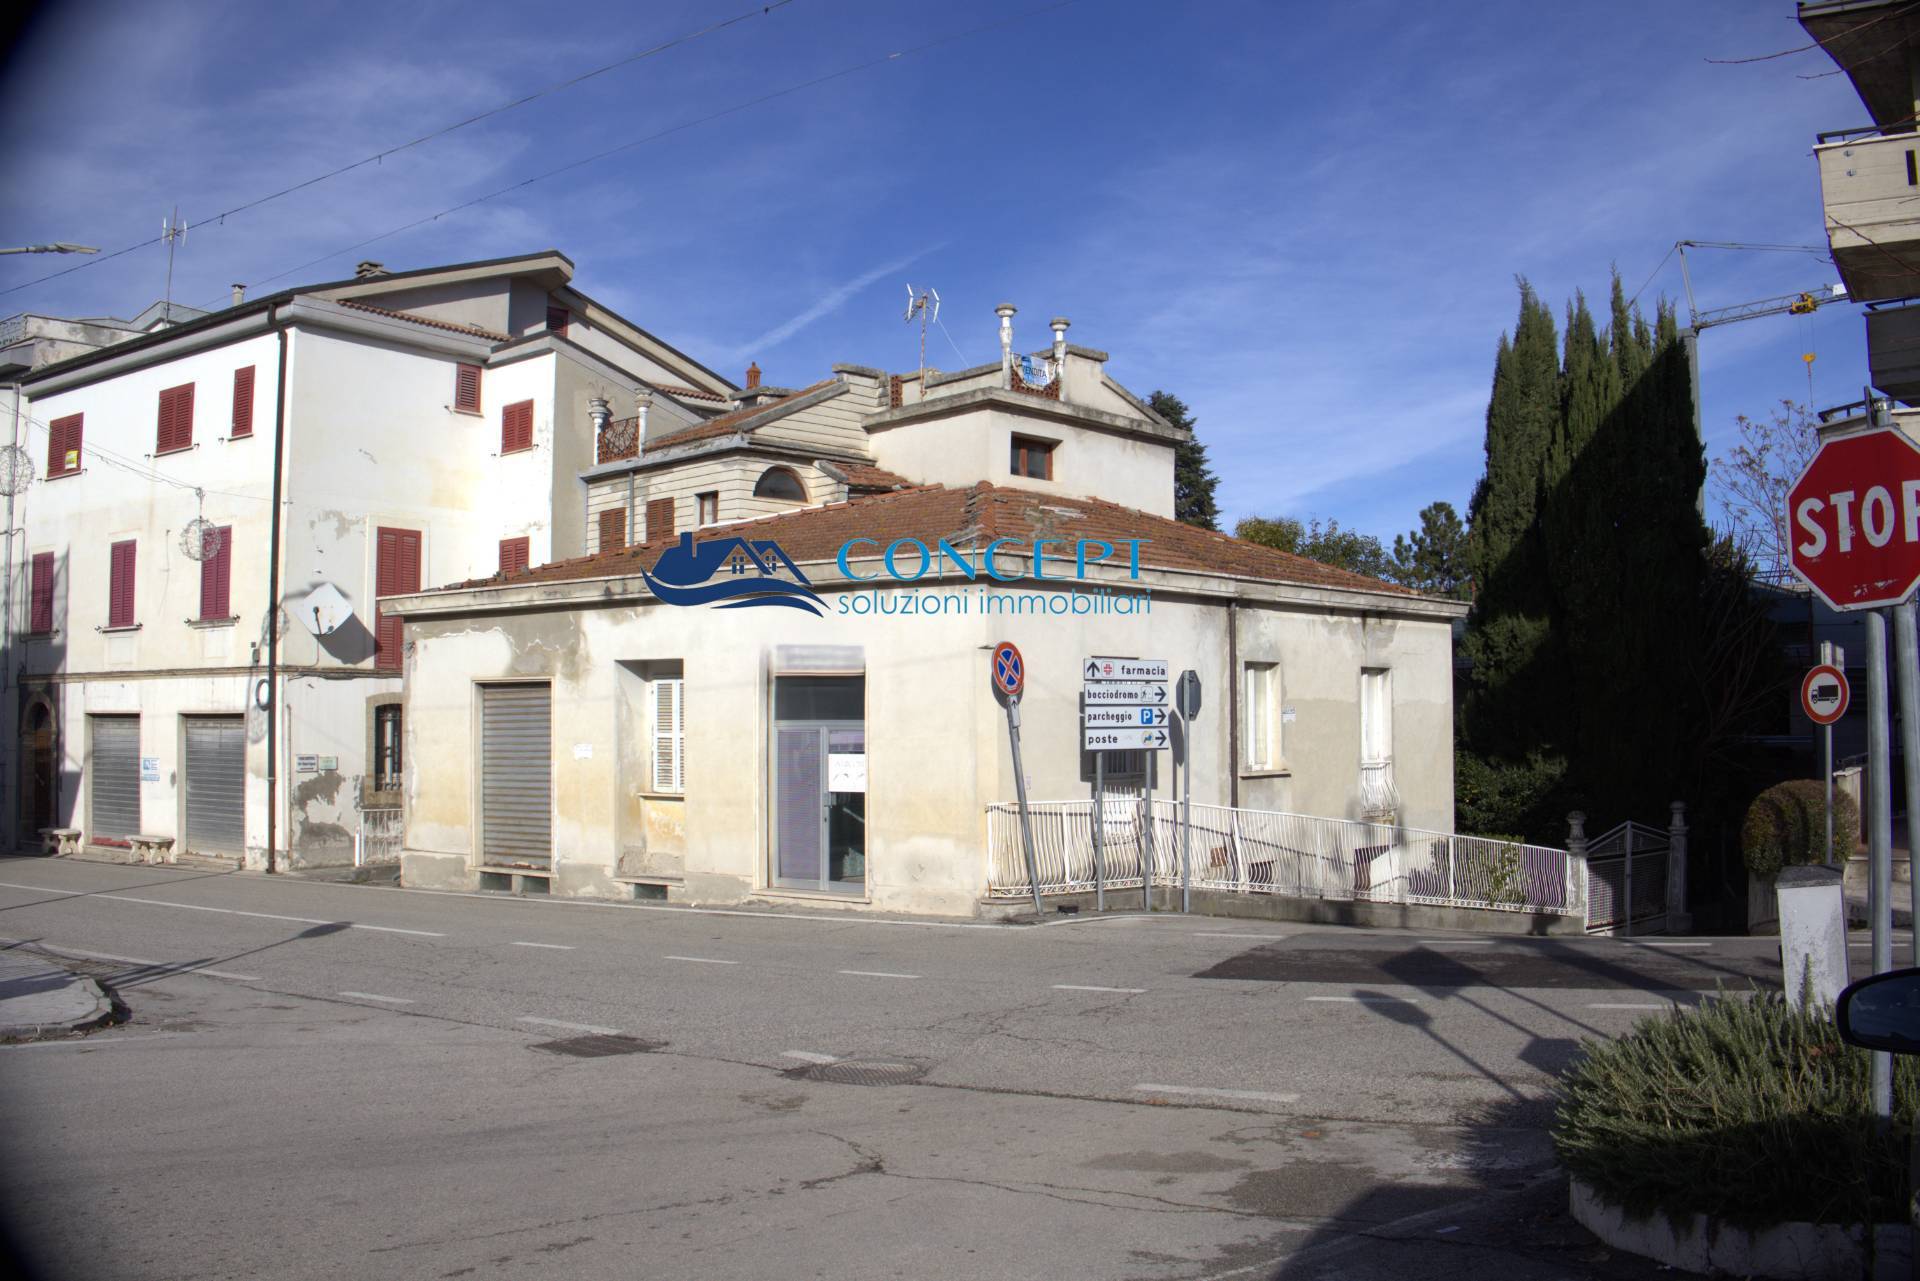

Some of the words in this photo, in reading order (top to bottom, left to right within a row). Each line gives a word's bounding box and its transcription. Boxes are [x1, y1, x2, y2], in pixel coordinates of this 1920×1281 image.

[1121, 665, 1166, 675] farmacia
[1087, 689, 1139, 699] bocciodromo
[1087, 711, 1132, 723] parcheggio
[1143, 710, 1151, 722] P
[1088, 734, 1118, 745] poste
